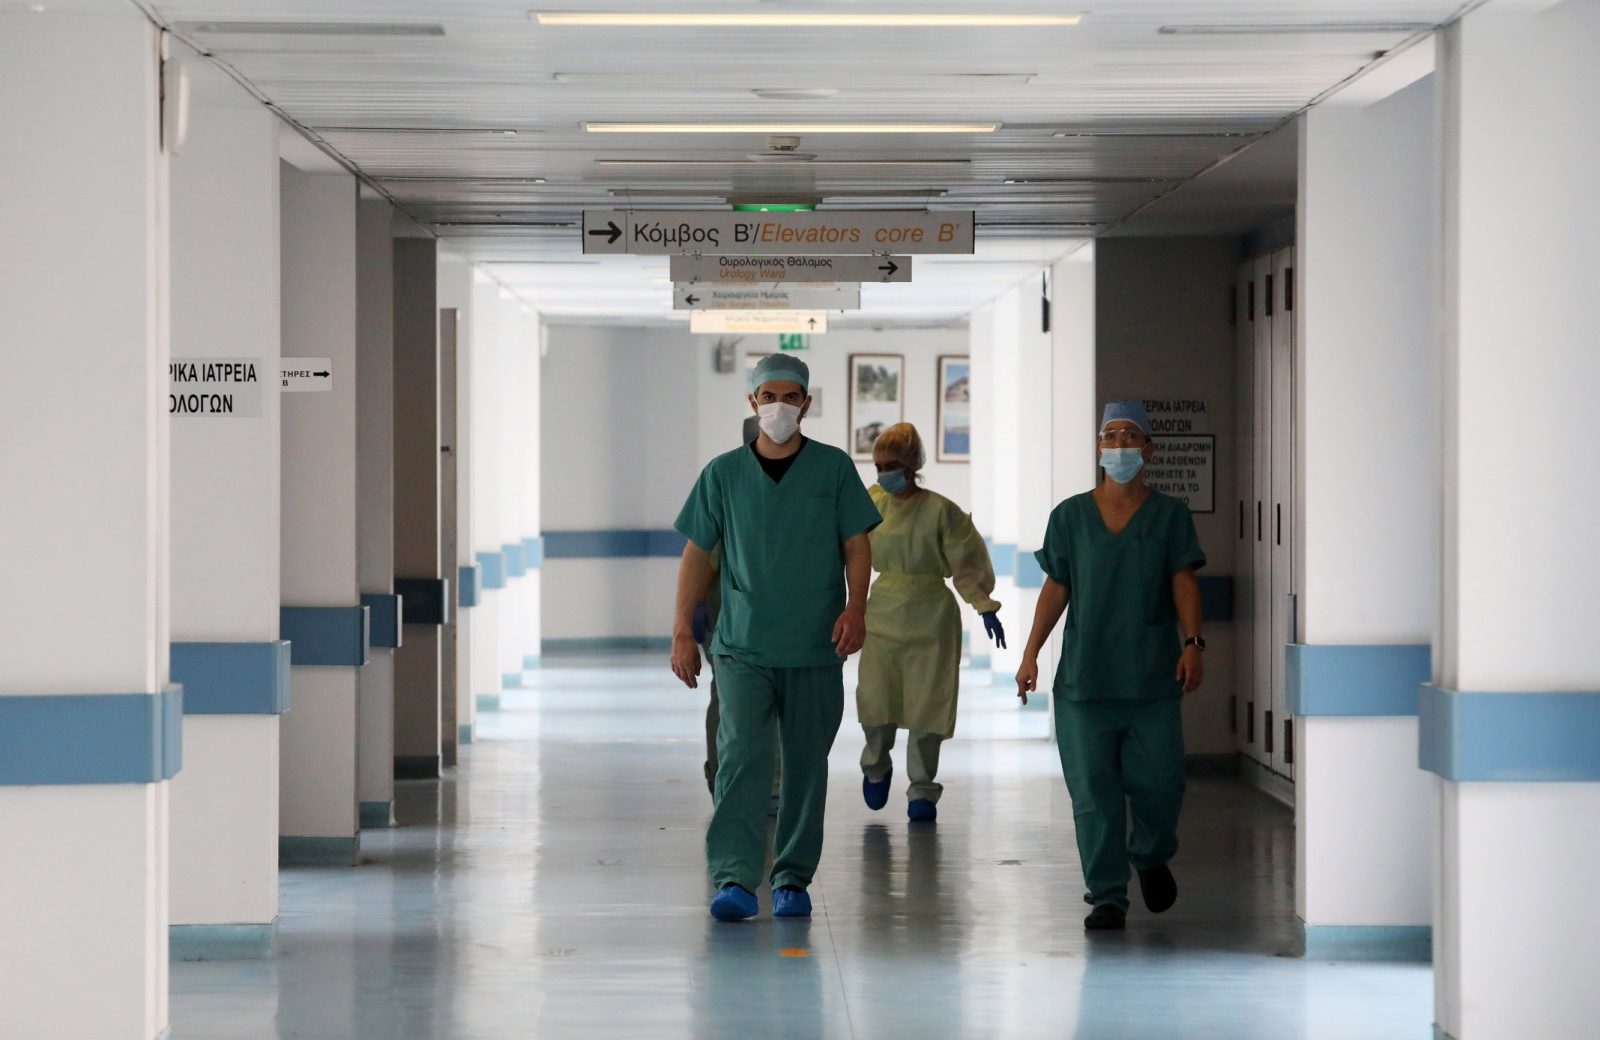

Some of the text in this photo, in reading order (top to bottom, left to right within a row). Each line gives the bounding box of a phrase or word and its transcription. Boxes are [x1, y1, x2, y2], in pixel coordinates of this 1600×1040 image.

[634, 222, 719, 247] Κόμβος
[875, 227, 924, 243] core
[937, 222, 960, 243] B'
[719, 256, 832, 269] Ουρολογικός Θάλαμος
[719, 268, 786, 280] Urology Ward
[202, 363, 257, 382] ΙΑΤΡΕΙΑ
[280, 370, 311, 378] ΤΗΡΕΣ
[1173, 400, 1206, 413] ΙΑΤΡΕΙΑ
[1148, 419, 1192, 432] ΟΛΟΓΩΝ
[1166, 456, 1207, 465] ΑΣΘΕΝΩΝ
[1186, 469, 1197, 479] ΤΑ
[1172, 482, 1186, 492] ΓΙΑ
[1188, 483, 1200, 492] ΤΟ
